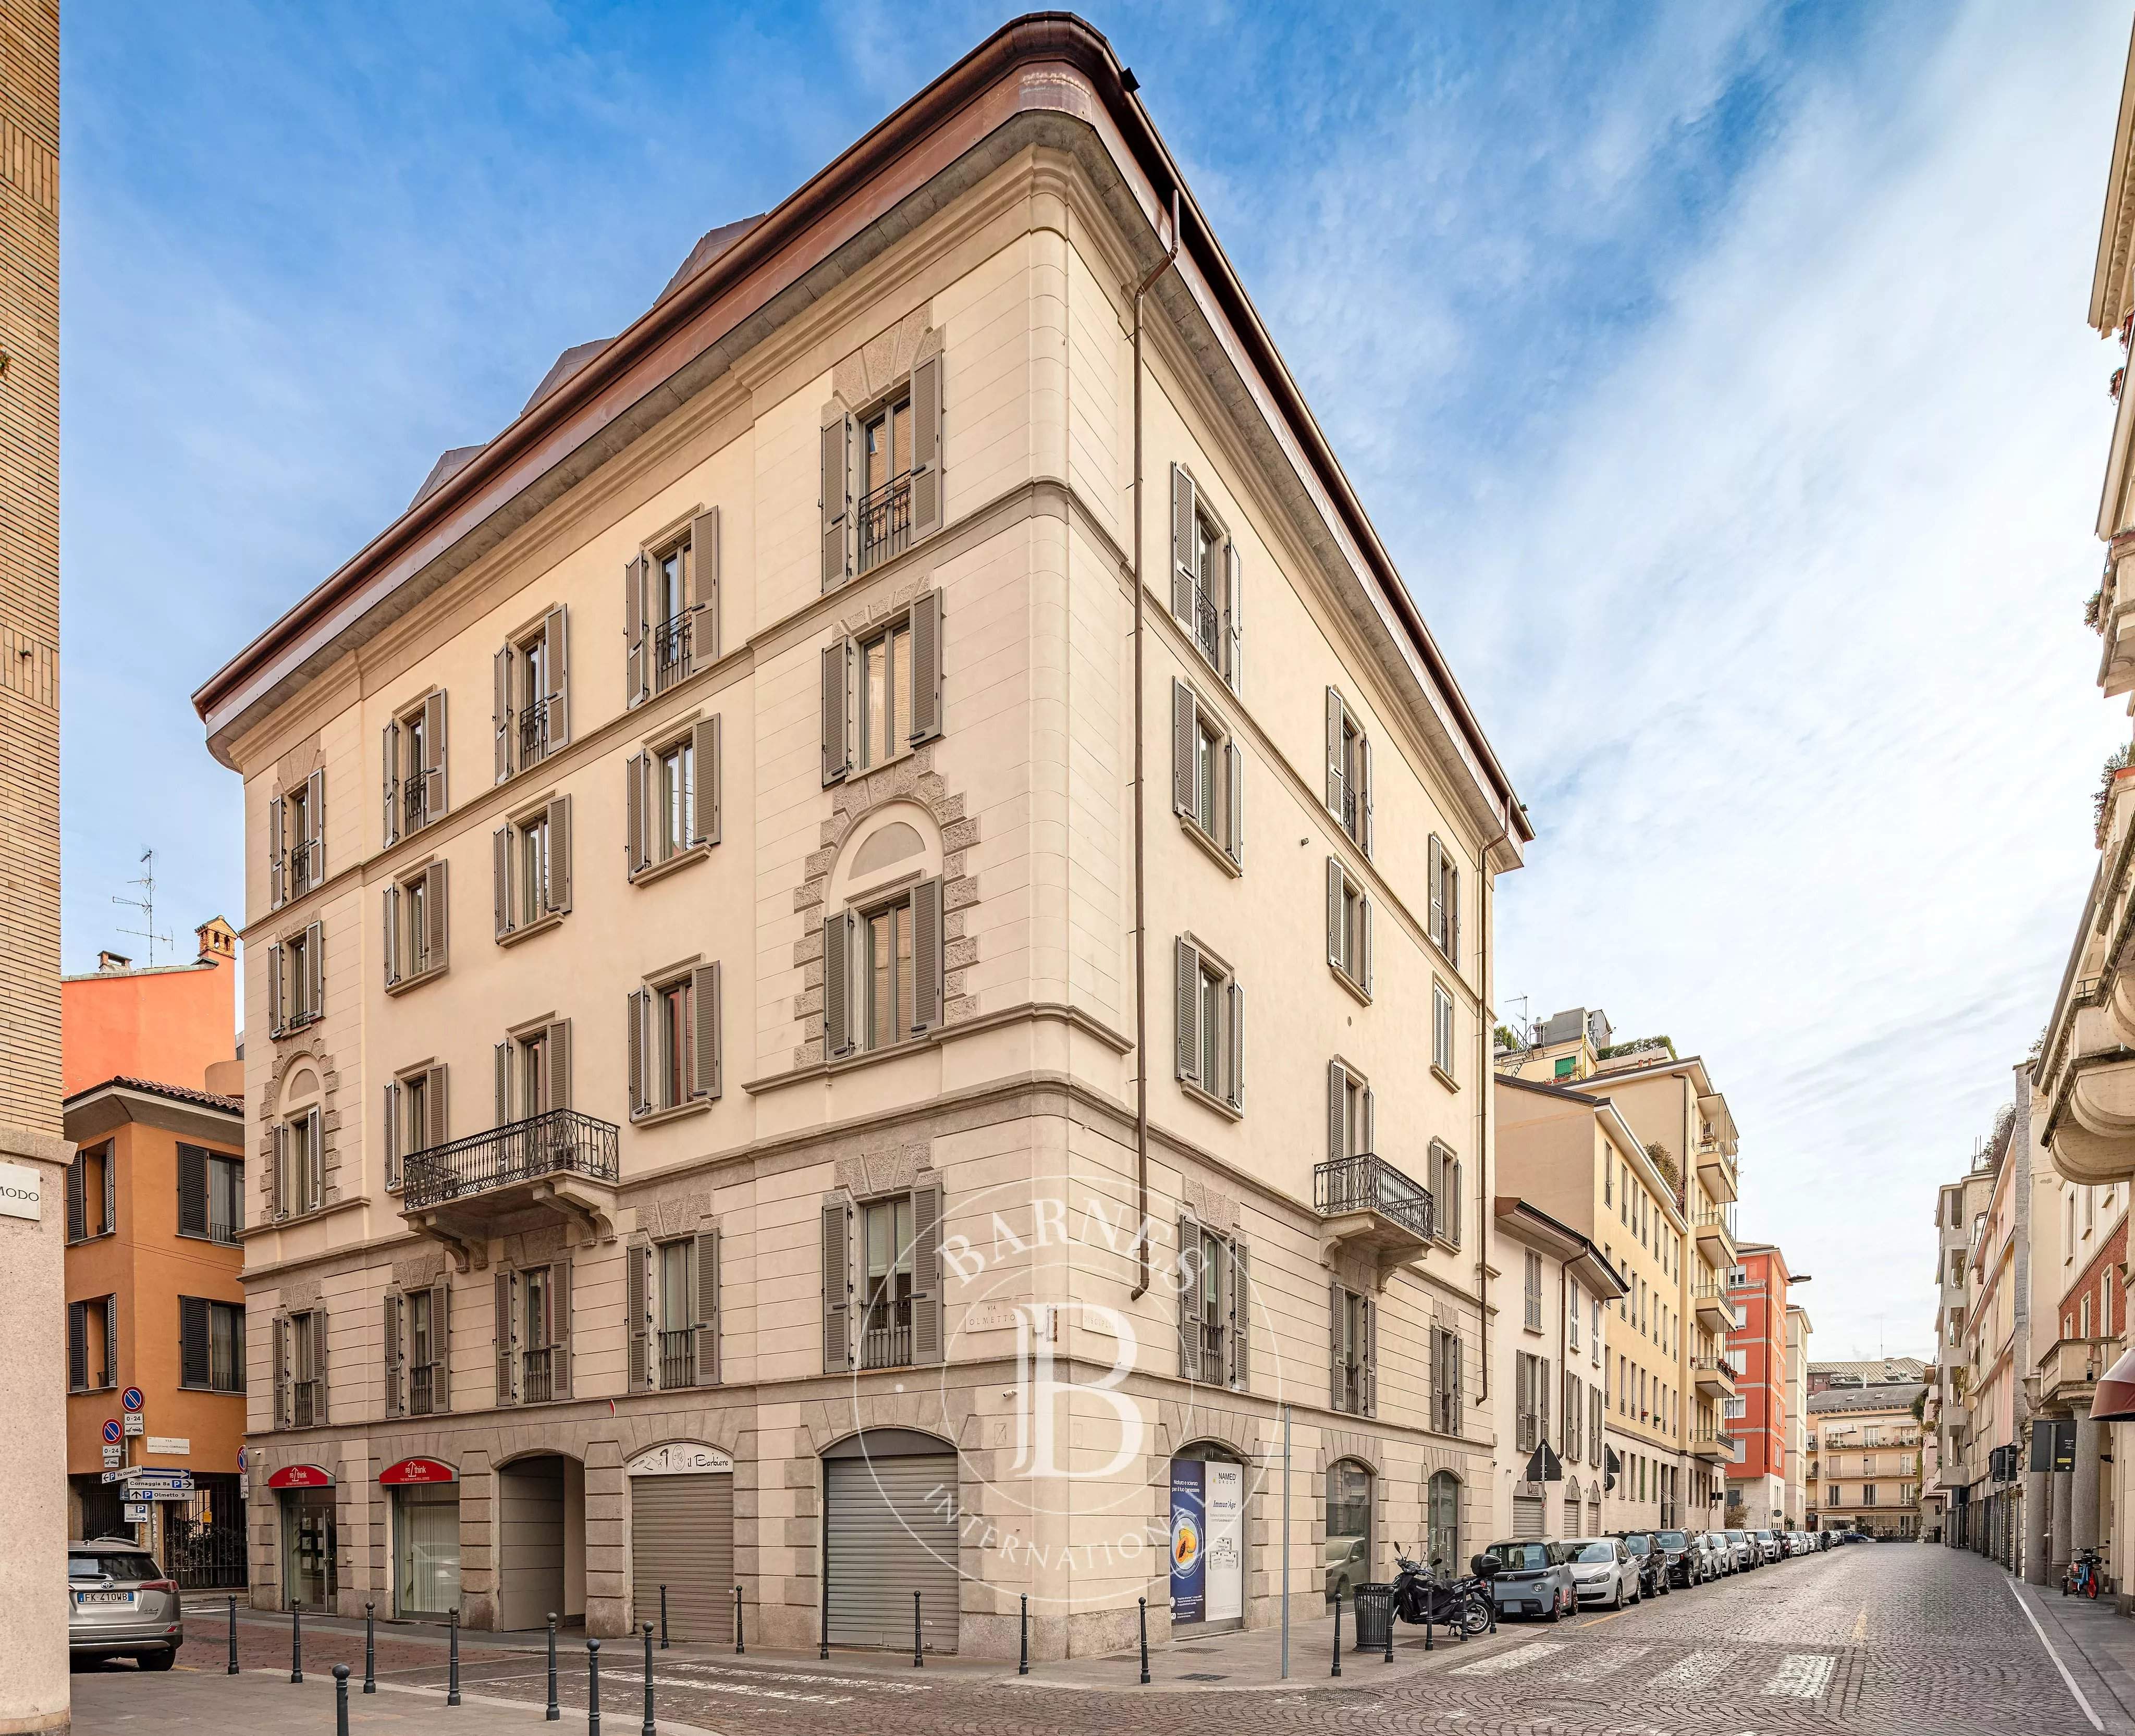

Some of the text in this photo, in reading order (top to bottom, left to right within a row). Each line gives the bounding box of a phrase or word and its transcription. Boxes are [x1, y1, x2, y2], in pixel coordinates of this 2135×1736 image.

[970, 1314, 1015, 1325] OLMETTO
[688, 1457, 692, 1467] il
[694, 1454, 728, 1467] Barbiere
[1219, 1472, 1236, 1481] NAMED
[100, 1593, 127, 1601] 410WB
